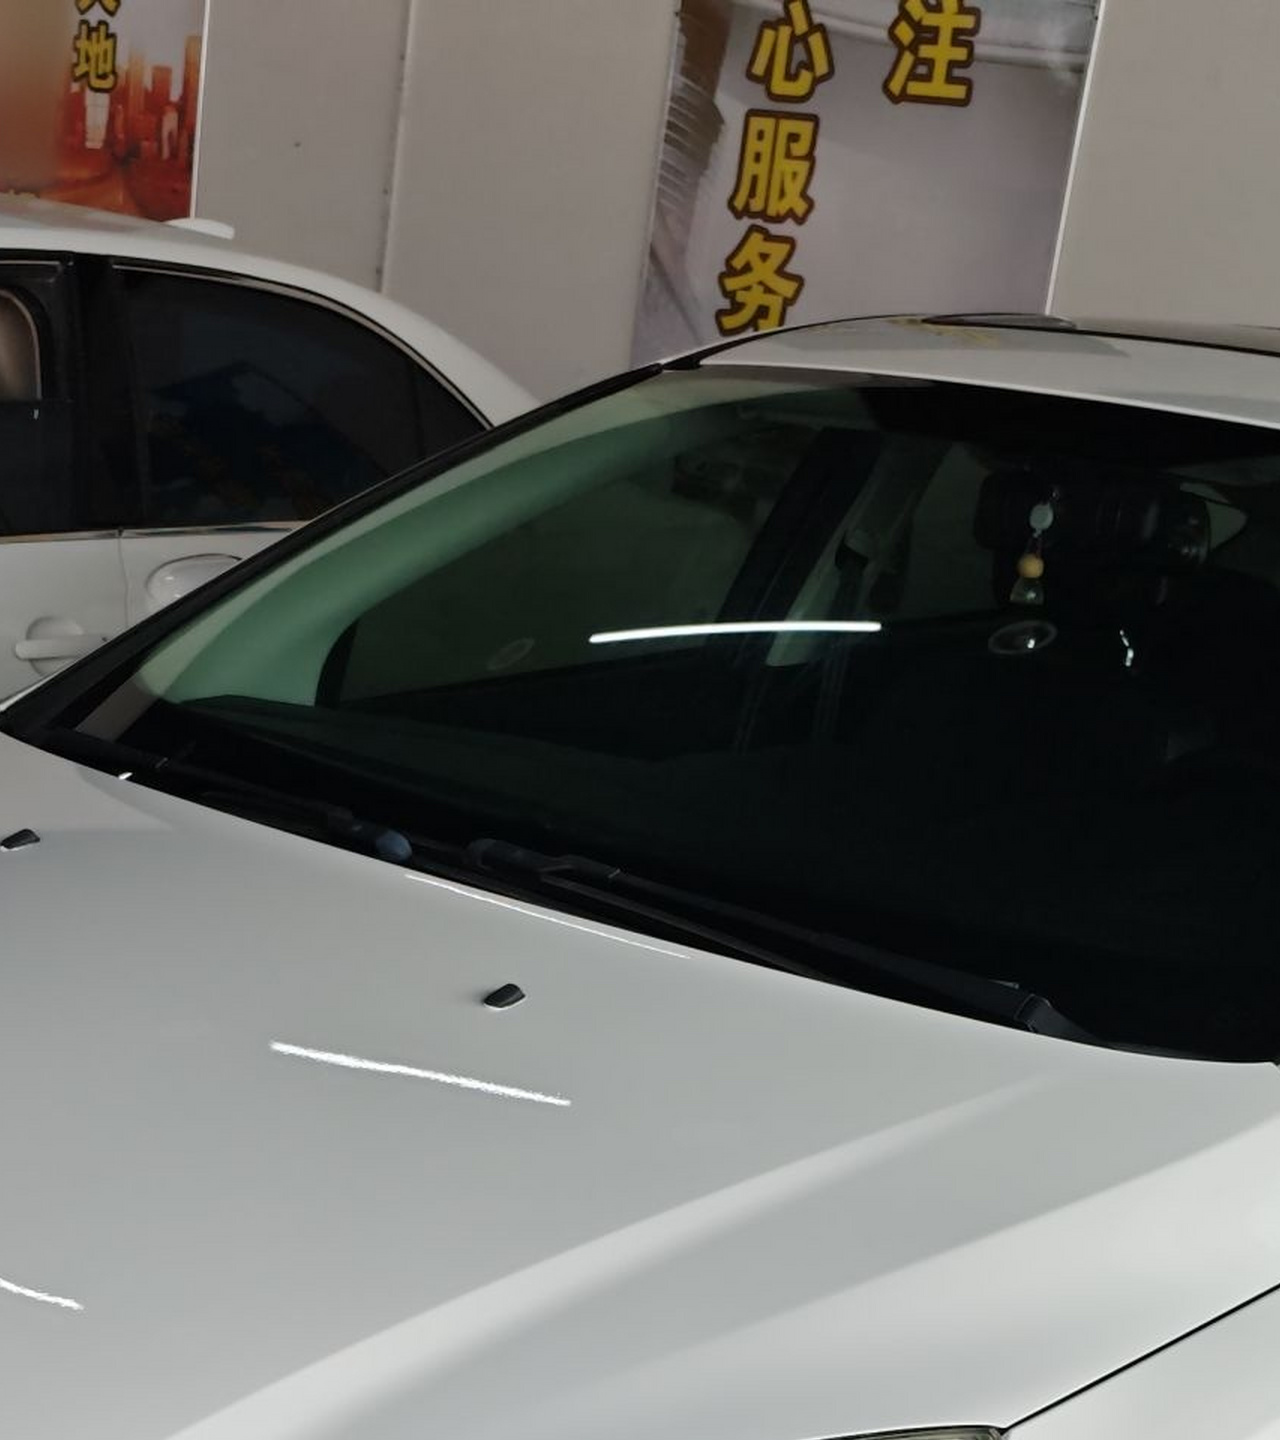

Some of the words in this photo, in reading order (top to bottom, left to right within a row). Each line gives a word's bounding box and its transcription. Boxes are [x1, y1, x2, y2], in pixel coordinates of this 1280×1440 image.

[883, 0, 981, 106] 注
[716, 0, 834, 336] 心服务
